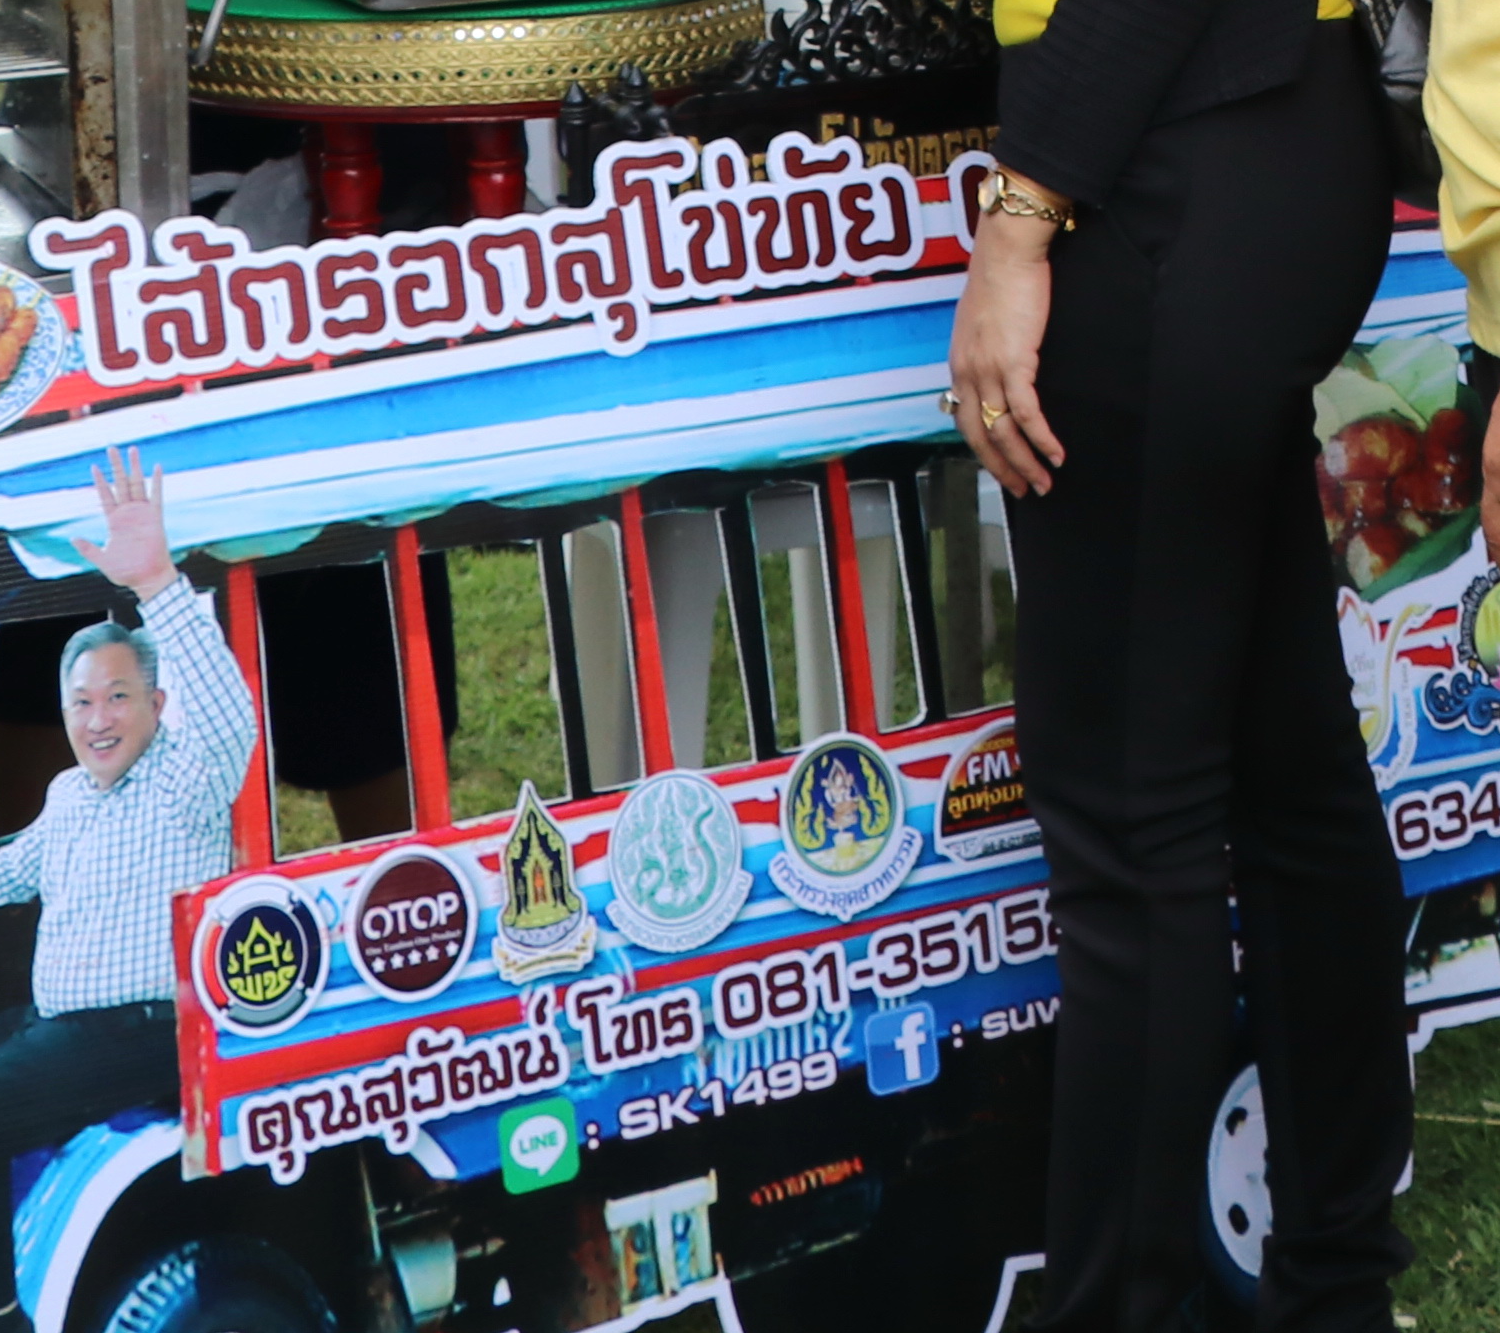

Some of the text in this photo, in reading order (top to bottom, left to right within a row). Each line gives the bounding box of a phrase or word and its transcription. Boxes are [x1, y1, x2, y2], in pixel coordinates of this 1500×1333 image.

[966, 750, 1012, 786] FM
[362, 890, 460, 941] OTOP
[238, 995, 570, 1185] คุณสุวัฒน์
[576, 971, 701, 1075] โทร
[618, 1049, 838, 1141] SK1499
[518, 1130, 559, 1156] LINE
